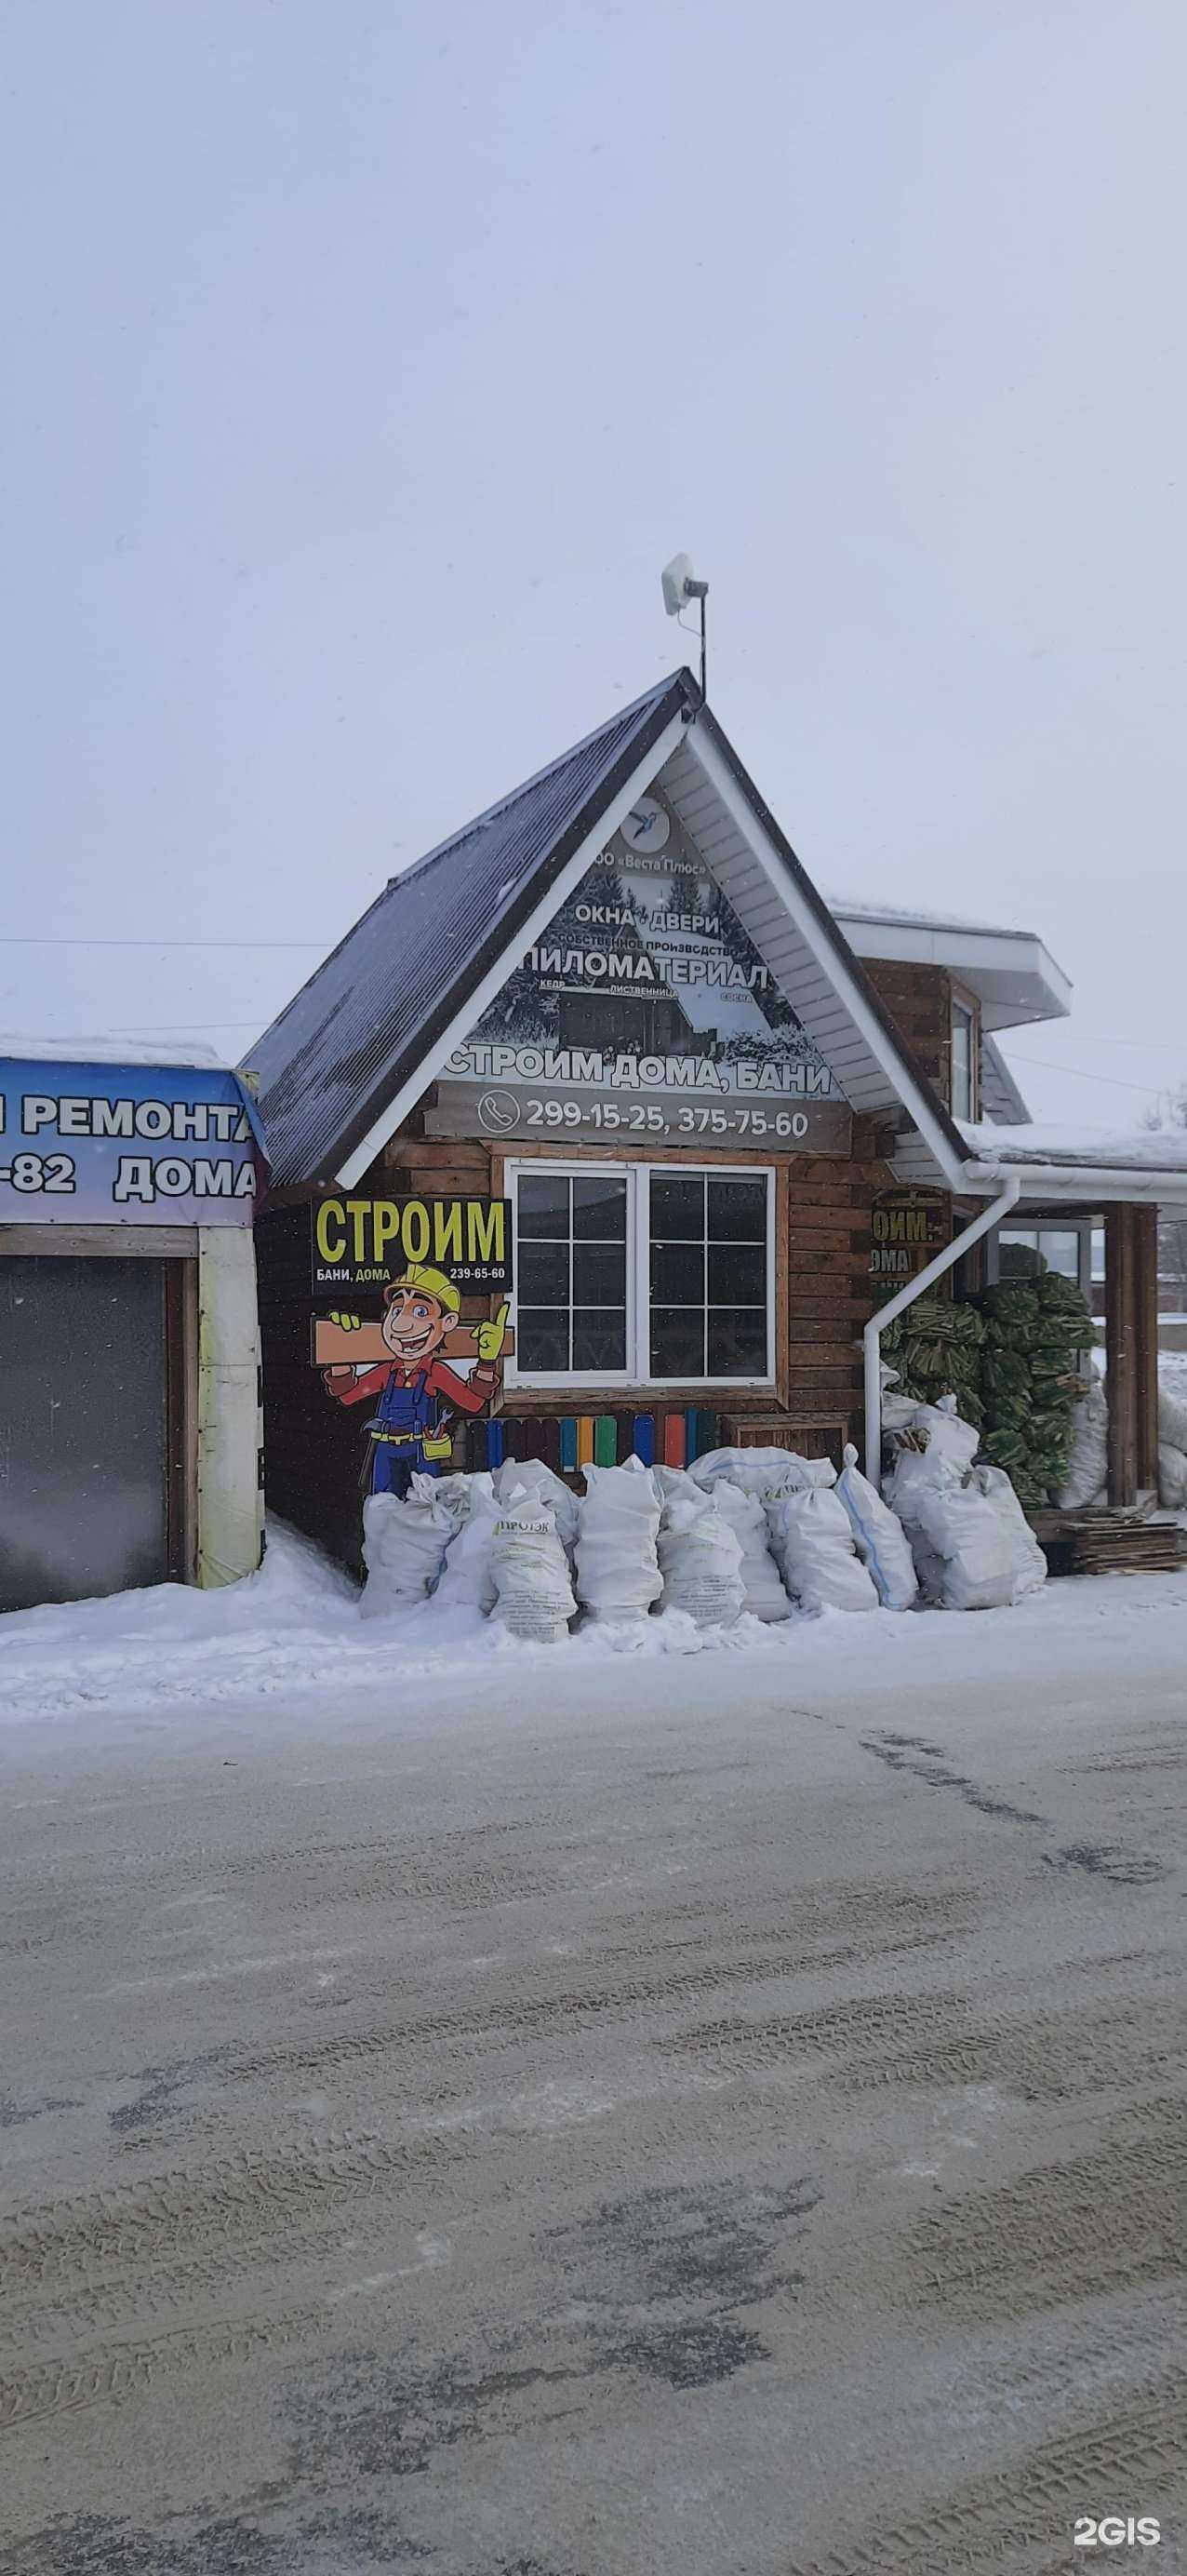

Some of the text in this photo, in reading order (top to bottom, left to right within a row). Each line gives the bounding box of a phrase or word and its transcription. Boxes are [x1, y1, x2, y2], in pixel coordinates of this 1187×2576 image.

[574, 903, 721, 934] ОКНА ДВЕРИ
[557, 933, 739, 957] СОБСТВЕННОЕ ПРОИЗВОДСТВО
[517, 947, 769, 990] ПИЛОМАТЕРИАЛ
[540, 978, 566, 988] КЕДР
[610, 984, 679, 999] ЛИСТВЕННИЦА
[445, 1042, 833, 1094] СТРОИМ ДОМА, БАНИ
[526, 1098, 809, 1138] 299-15-25, 375-75-60
[113, 1156, 257, 1203] ДОМА
[316, 1199, 505, 1264] СТРОИМ
[316, 1268, 505, 1283] БАНИ, ДОМА 239-65-60
